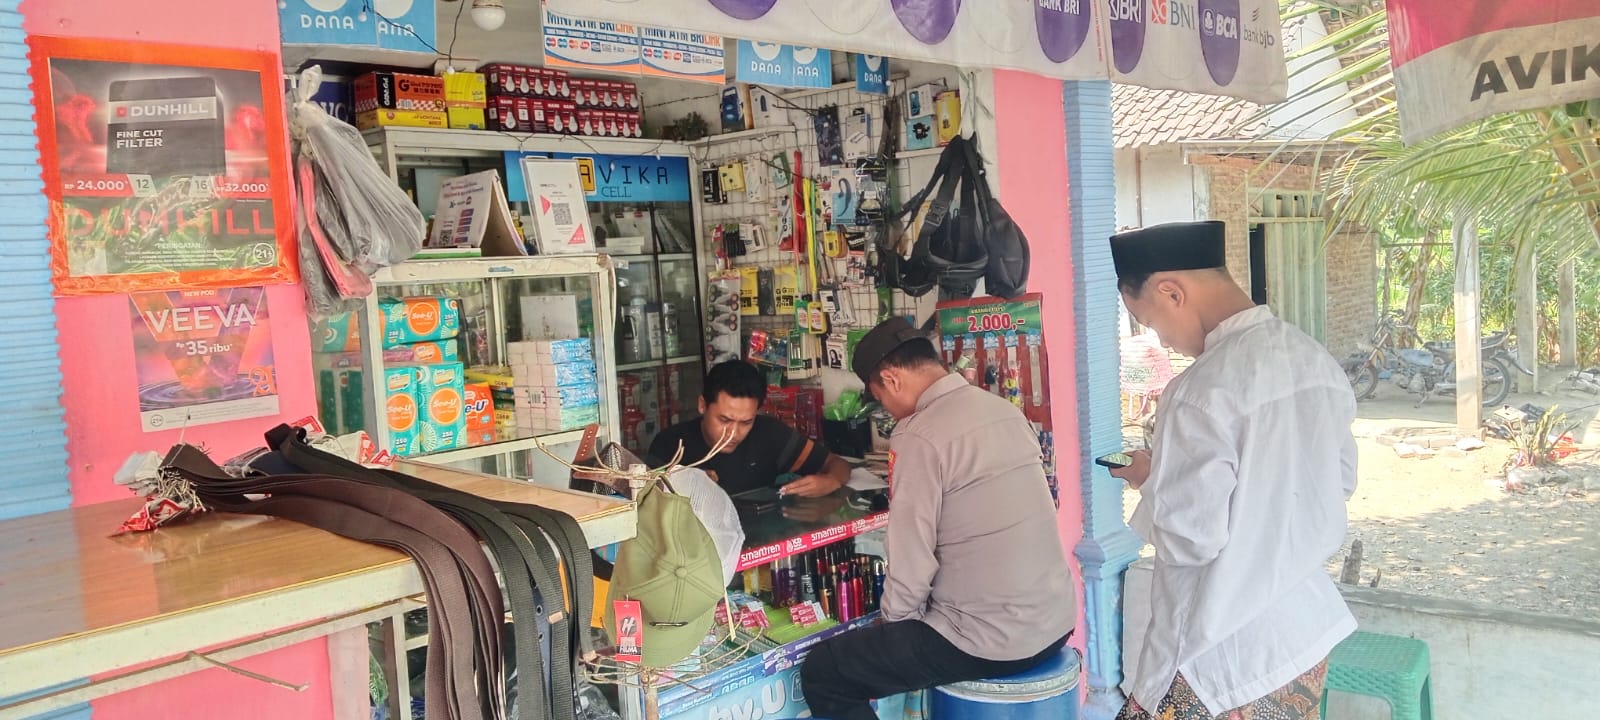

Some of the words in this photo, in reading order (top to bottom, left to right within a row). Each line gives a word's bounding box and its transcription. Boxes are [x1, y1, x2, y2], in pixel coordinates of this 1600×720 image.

[1064, 0, 1080, 15] BRI
[1119, 0, 1142, 23] BRI
[300, 14, 354, 30] DANA
[547, 12, 572, 27] MINI
[574, 19, 597, 30] ATM
[1170, 5, 1196, 30] BNI
[378, 23, 415, 37] ANA
[1215, 14, 1238, 39] BCA
[1243, 24, 1259, 42] bank
[1259, 26, 1275, 49] bjb
[751, 60, 782, 75] DANA
[793, 65, 819, 77] ANA
[1470, 44, 1600, 102] AVIK
[864, 72, 883, 84] DANA
[130, 103, 209, 118] DUNHILL
[116, 130, 140, 139] FINE
[142, 129, 164, 138] CUT
[116, 138, 163, 149] FILTER
[135, 179, 150, 189] 12
[194, 180, 208, 190] 16
[601, 186, 632, 198] CELL
[65, 207, 275, 237] DUNHILL
[255, 249, 273, 259] 21+
[145, 303, 257, 333] VEEVA
[967, 312, 1026, 332] 2.000,-
[186, 340, 208, 356] 35
[464, 400, 488, 414] e-U
[740, 544, 781, 562] smartfren
